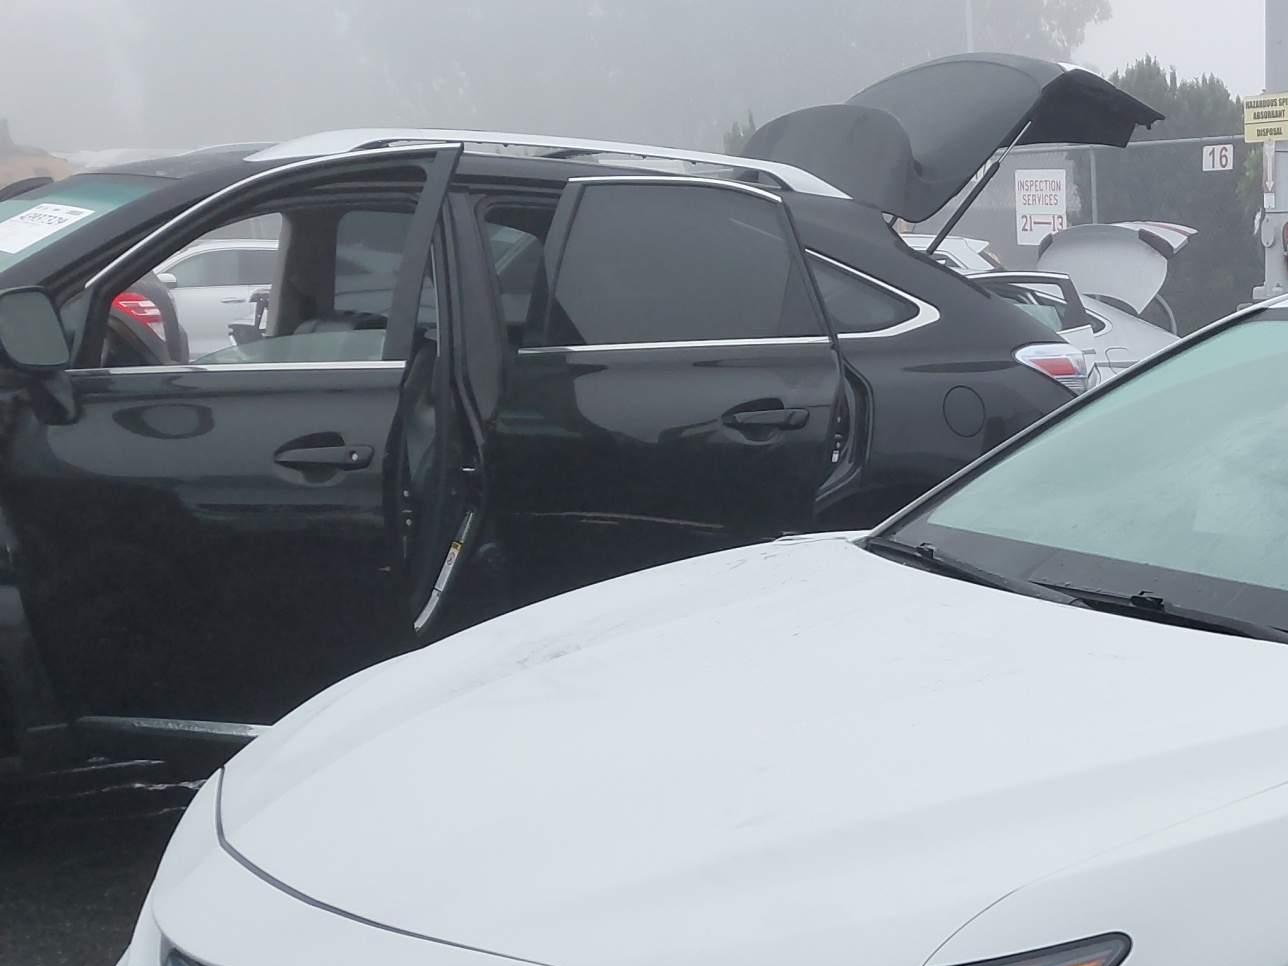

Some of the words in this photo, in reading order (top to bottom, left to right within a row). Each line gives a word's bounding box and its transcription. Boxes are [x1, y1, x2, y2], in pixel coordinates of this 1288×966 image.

[1245, 98, 1278, 109] HAZARDOUS
[1256, 127, 1283, 137] DISPOSAL
[1208, 146, 1229, 169] 16
[1017, 179, 1062, 192] INSPECTION
[1022, 193, 1059, 206] SERVICES
